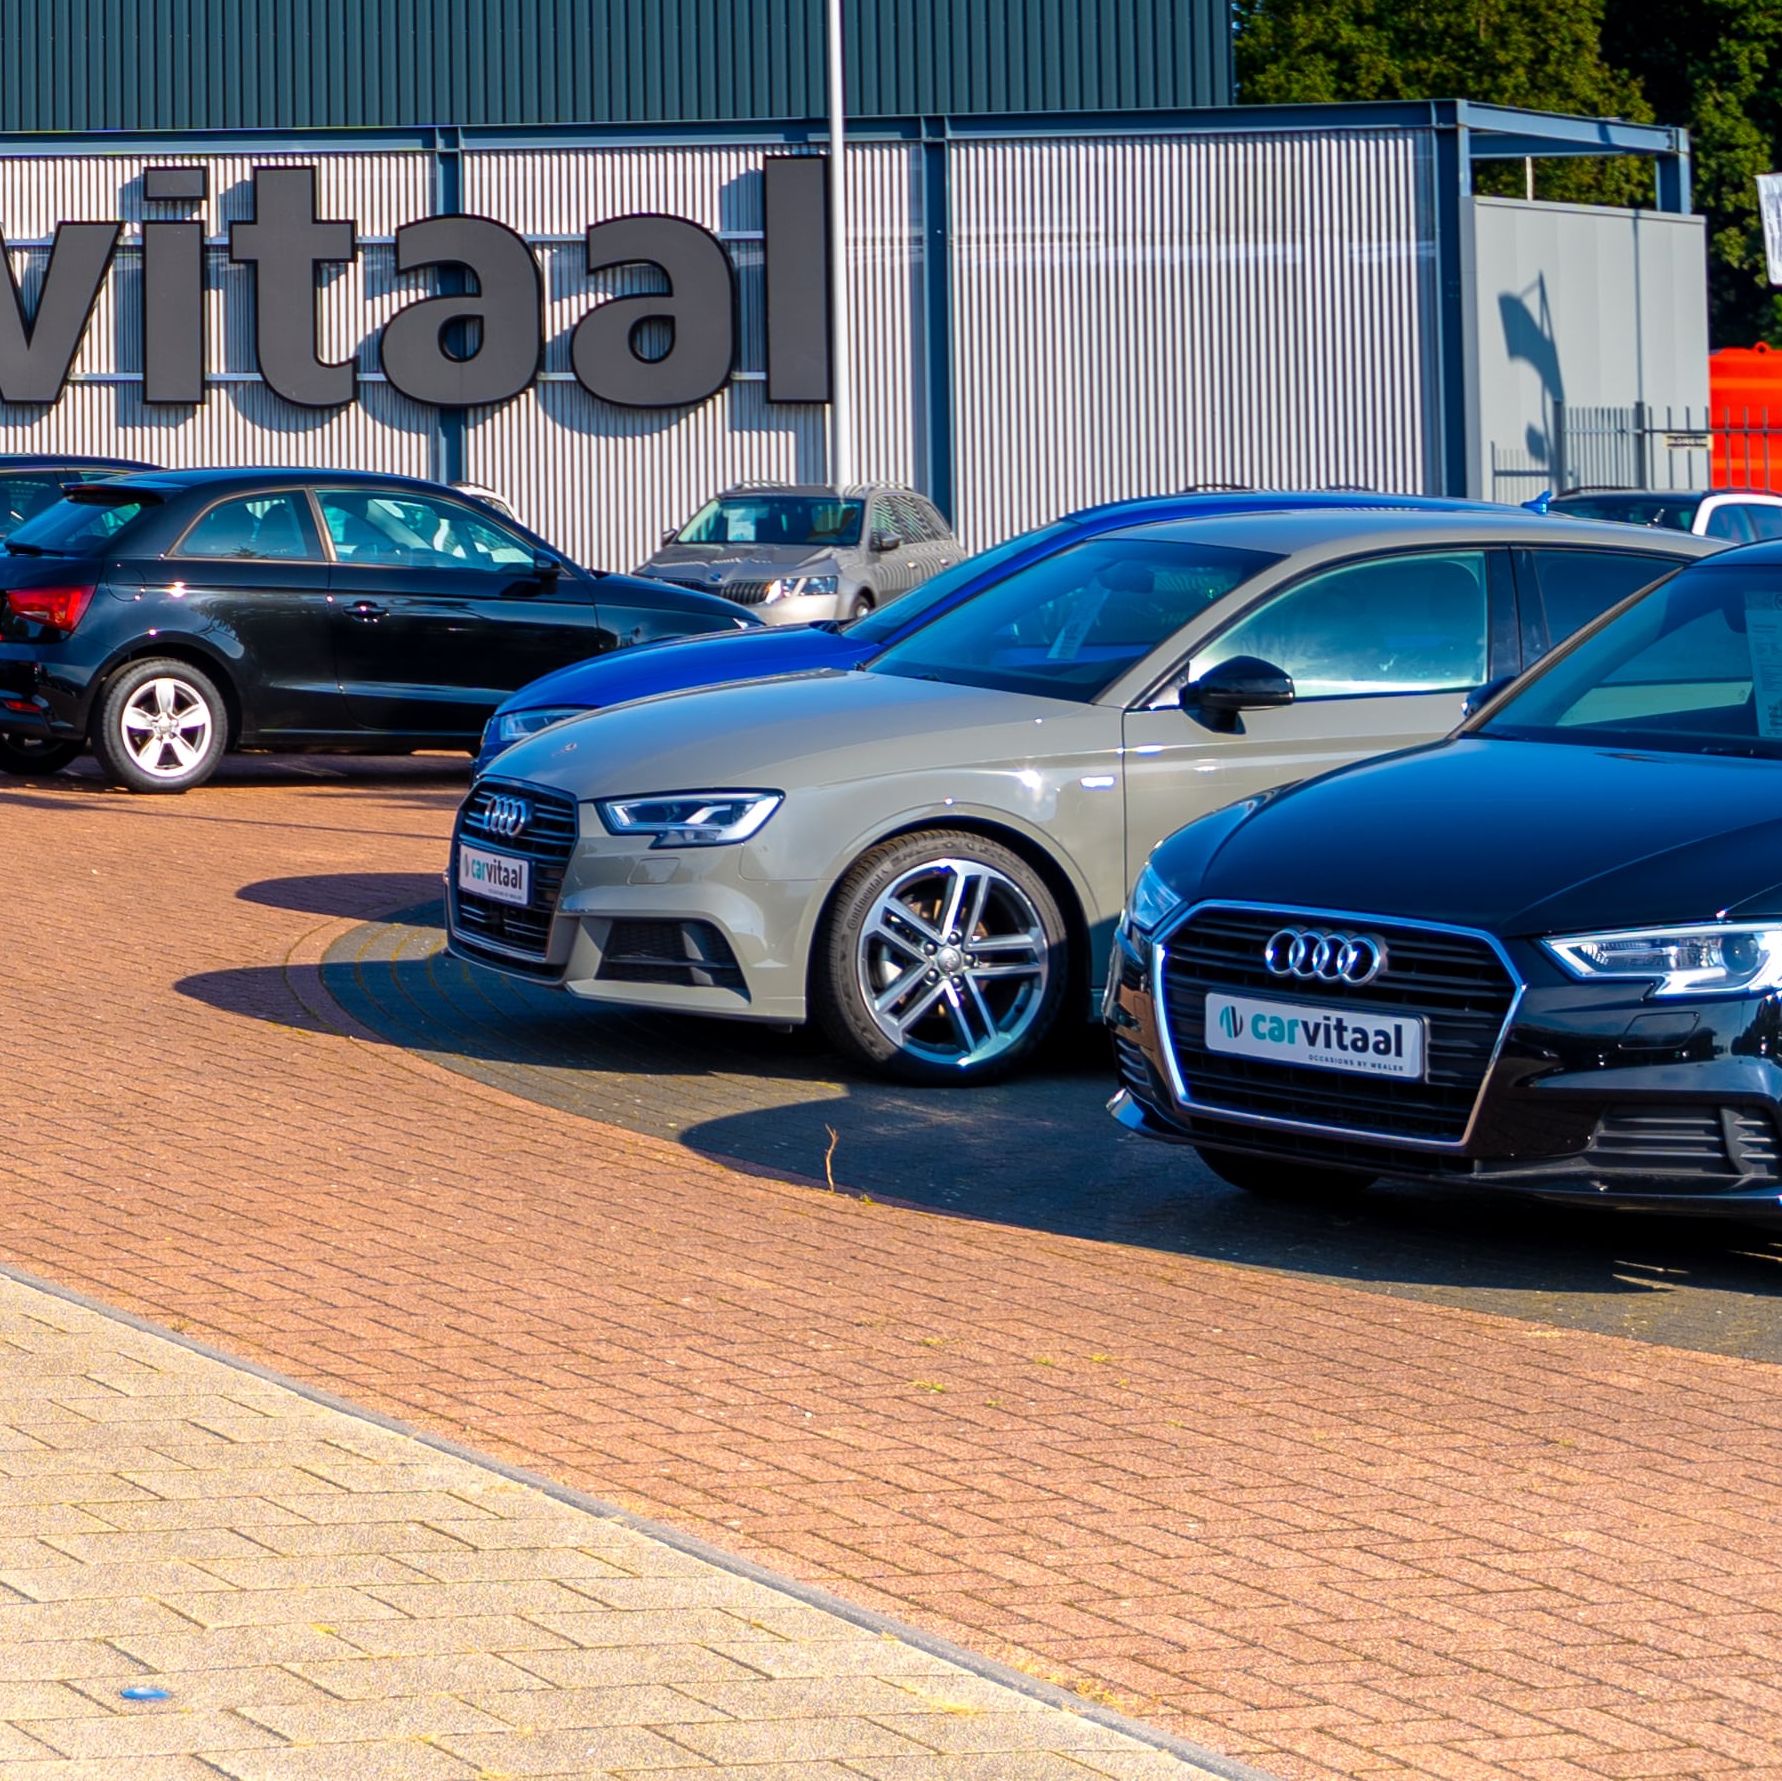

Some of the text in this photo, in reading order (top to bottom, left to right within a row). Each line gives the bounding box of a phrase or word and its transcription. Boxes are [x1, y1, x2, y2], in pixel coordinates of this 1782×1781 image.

[471, 858, 523, 890] carvitaal
[1251, 1013, 1404, 1058] carvitaal
[1308, 1054, 1354, 1066] OCCASIONS
[1370, 1062, 1404, 1072] WEALER
